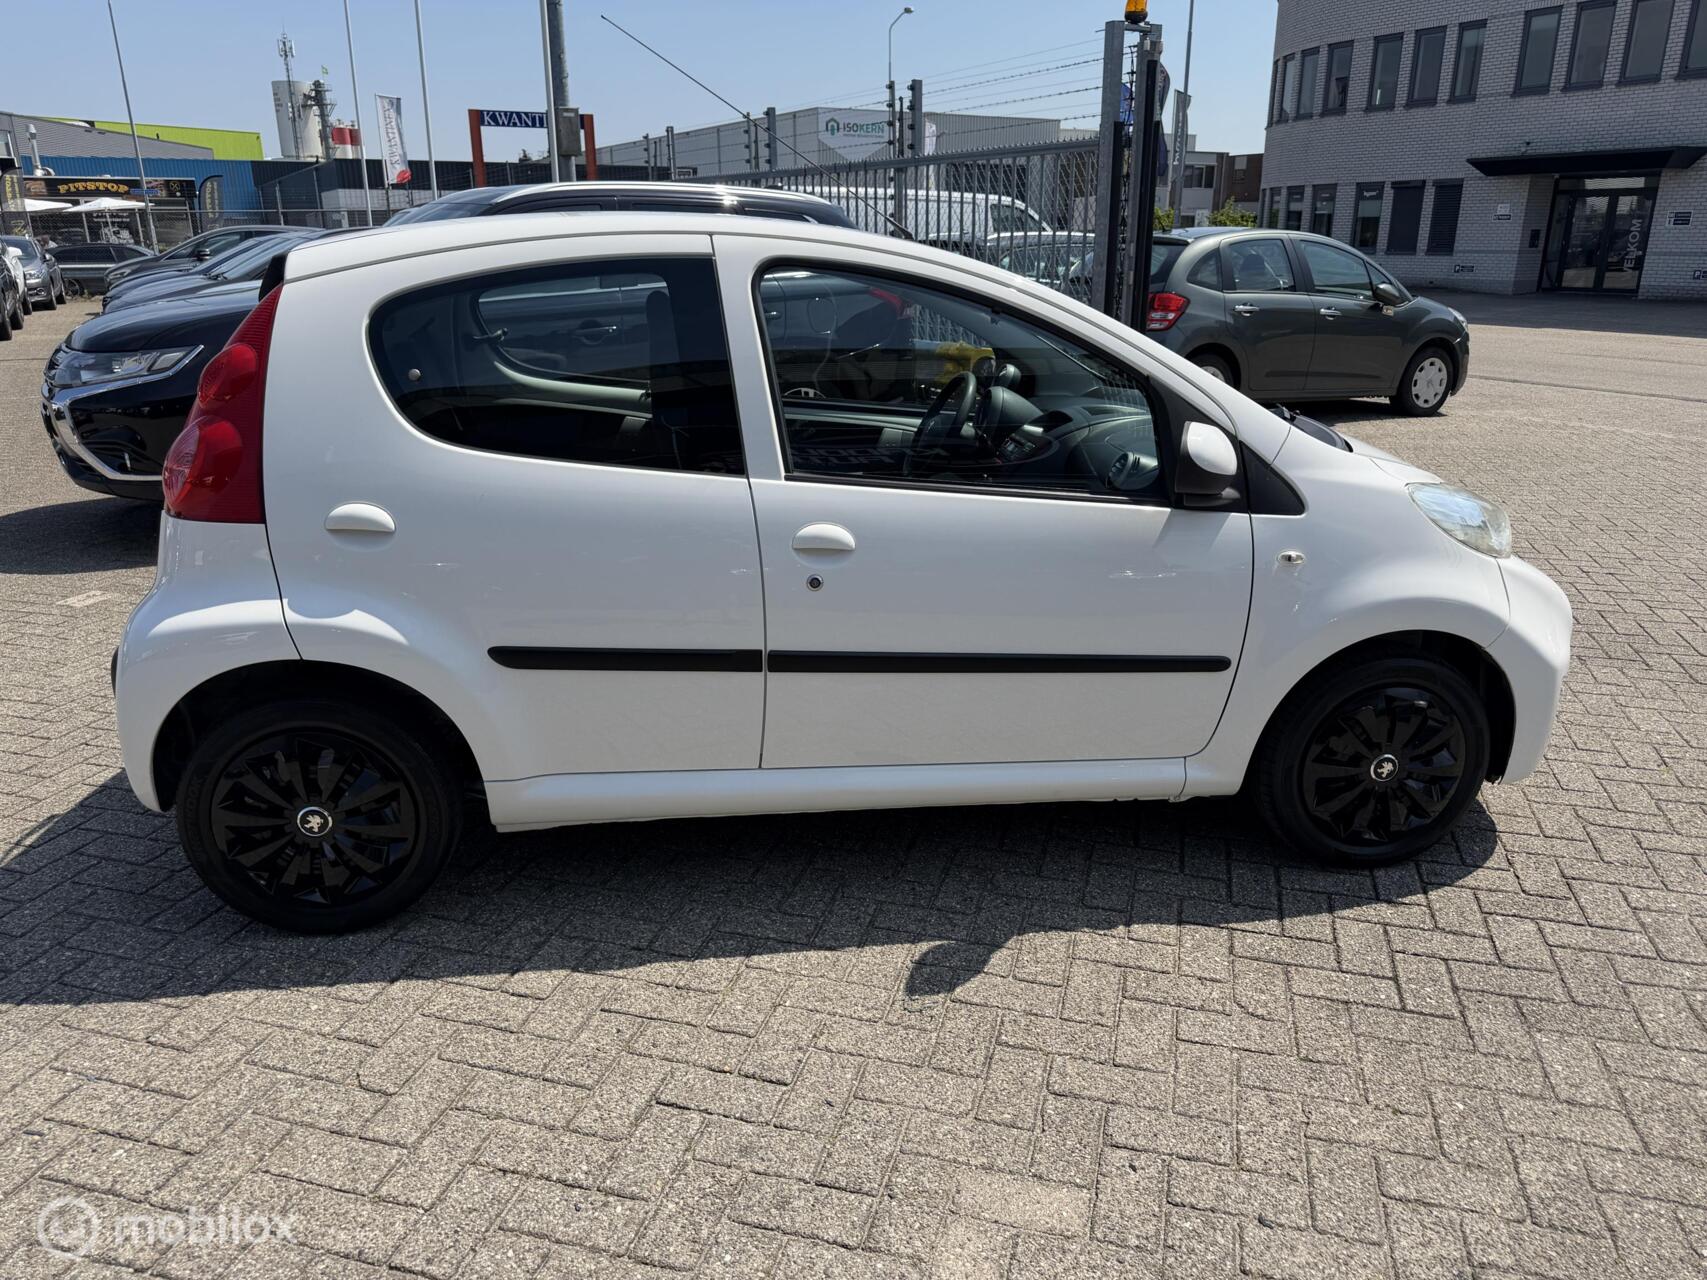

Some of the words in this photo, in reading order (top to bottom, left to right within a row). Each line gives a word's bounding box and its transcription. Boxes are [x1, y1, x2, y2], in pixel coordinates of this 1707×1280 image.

[483, 111, 547, 127] KWANTI
[842, 122, 885, 134] ISOKERN
[58, 181, 129, 194] PITSTOP
